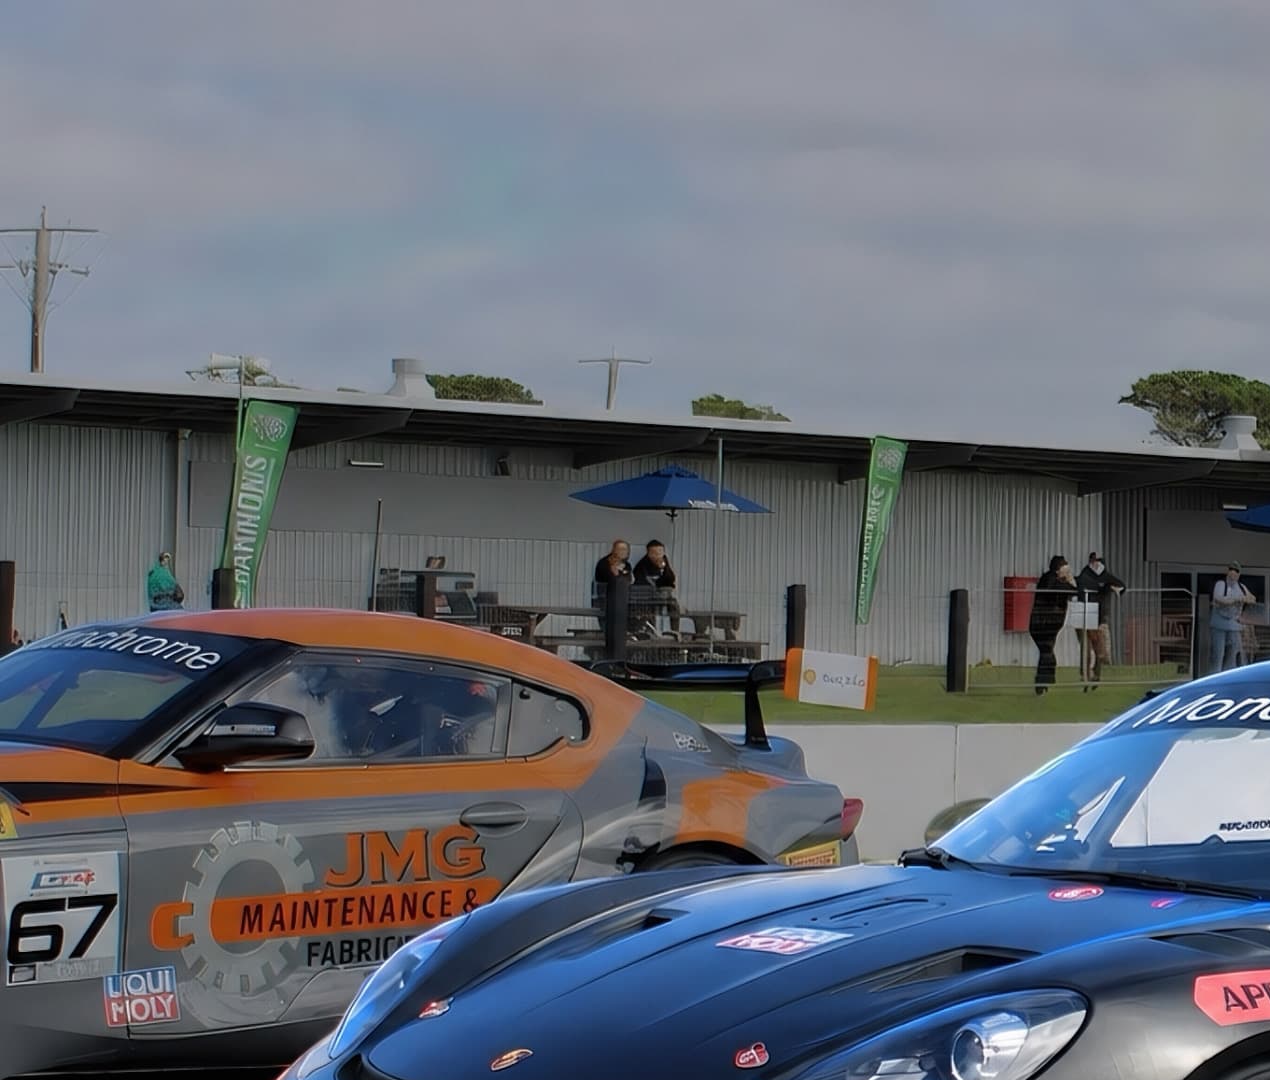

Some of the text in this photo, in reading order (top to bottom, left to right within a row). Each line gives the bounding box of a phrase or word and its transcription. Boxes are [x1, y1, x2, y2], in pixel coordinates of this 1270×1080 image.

[324, 823, 486, 888] JMG
[7, 894, 118, 965] 67
[239, 890, 453, 935] MAINTENANCE
